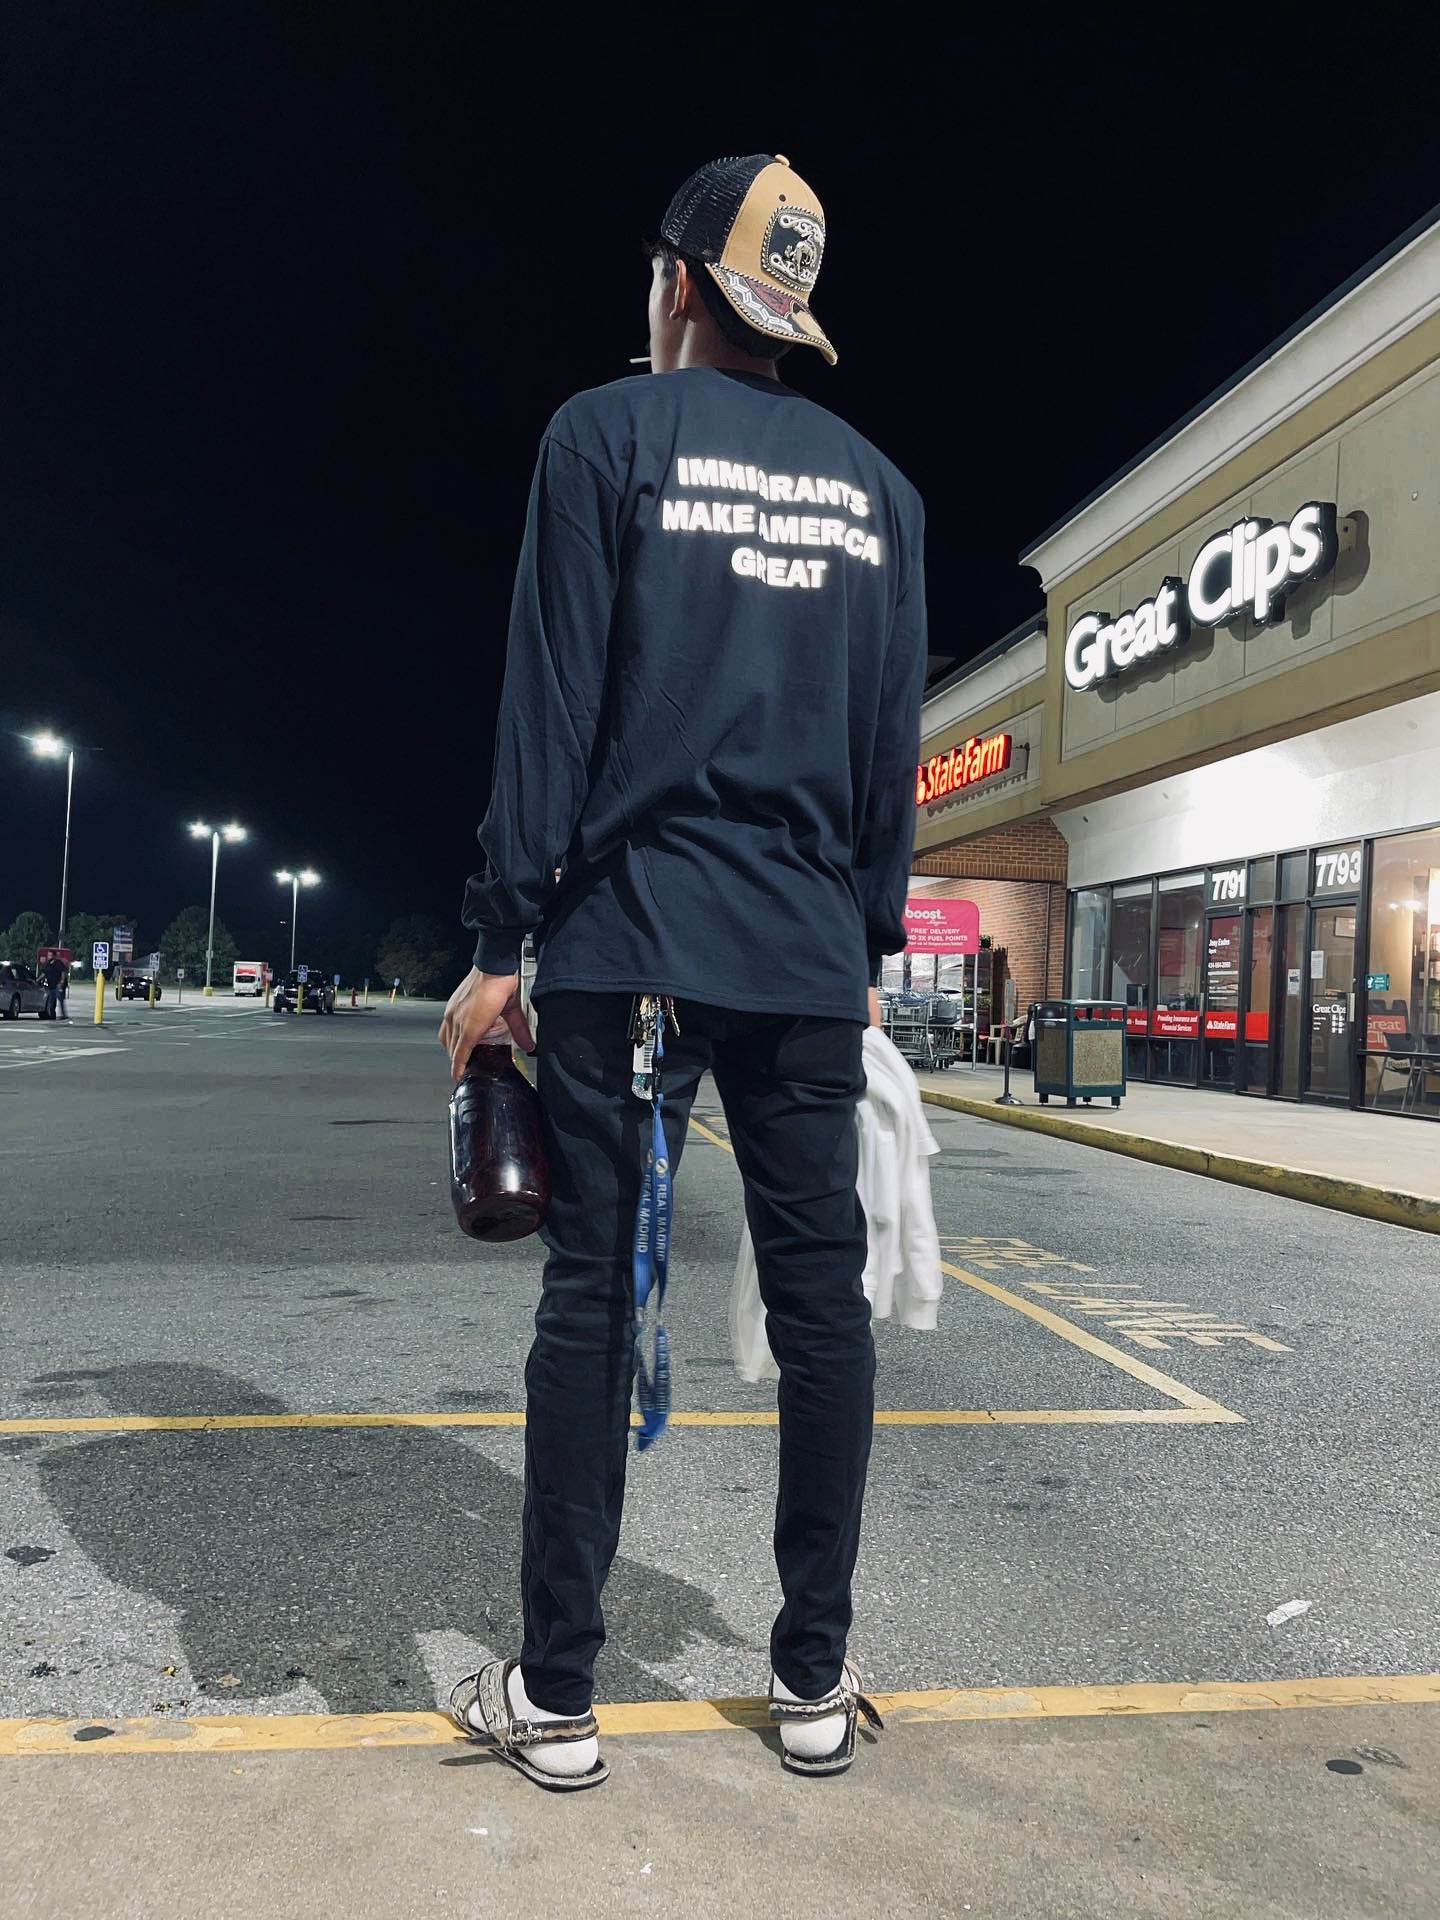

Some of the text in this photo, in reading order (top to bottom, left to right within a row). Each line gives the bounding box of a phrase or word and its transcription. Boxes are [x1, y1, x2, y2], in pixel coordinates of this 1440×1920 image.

[677, 457, 869, 517] IMMIGRANTS
[662, 499, 880, 566] MAKE AMERCA
[731, 547, 827, 588] GREAT
[1065, 506, 1321, 688] Great Clips
[1212, 868, 1246, 900] 7791
[1316, 850, 1361, 887] 7793
[905, 905, 942, 919] boost
[1157, 1014, 1172, 1023] Providing
[1161, 1023, 1192, 1032] Financial Services
[1313, 1004, 1331, 1014] Great
[637, 1174, 652, 1253] REAL MADRID
[656, 1183, 668, 1261] REAL MADRID
